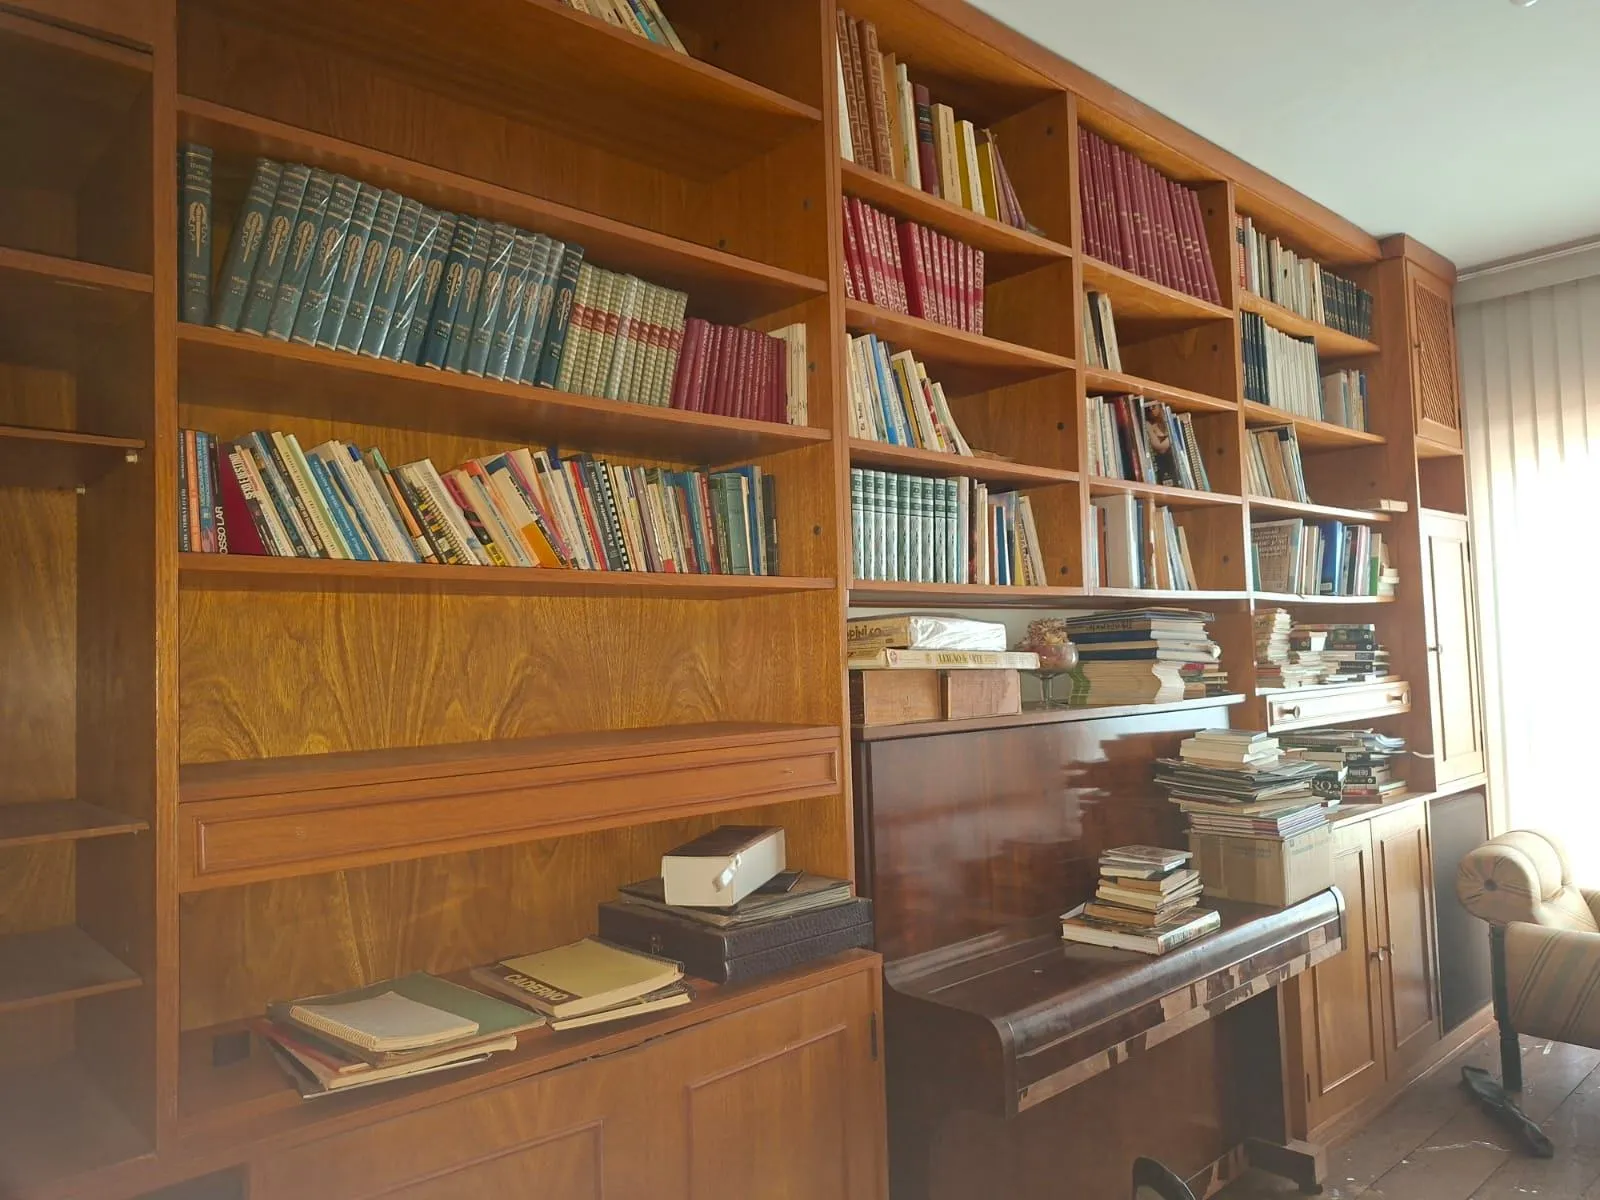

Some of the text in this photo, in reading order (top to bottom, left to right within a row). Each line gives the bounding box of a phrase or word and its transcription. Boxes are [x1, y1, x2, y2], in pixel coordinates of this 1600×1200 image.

[215, 506, 225, 526] LAR
[600, 504, 611, 532] rencontre
[503, 974, 569, 1001] CADERNO
